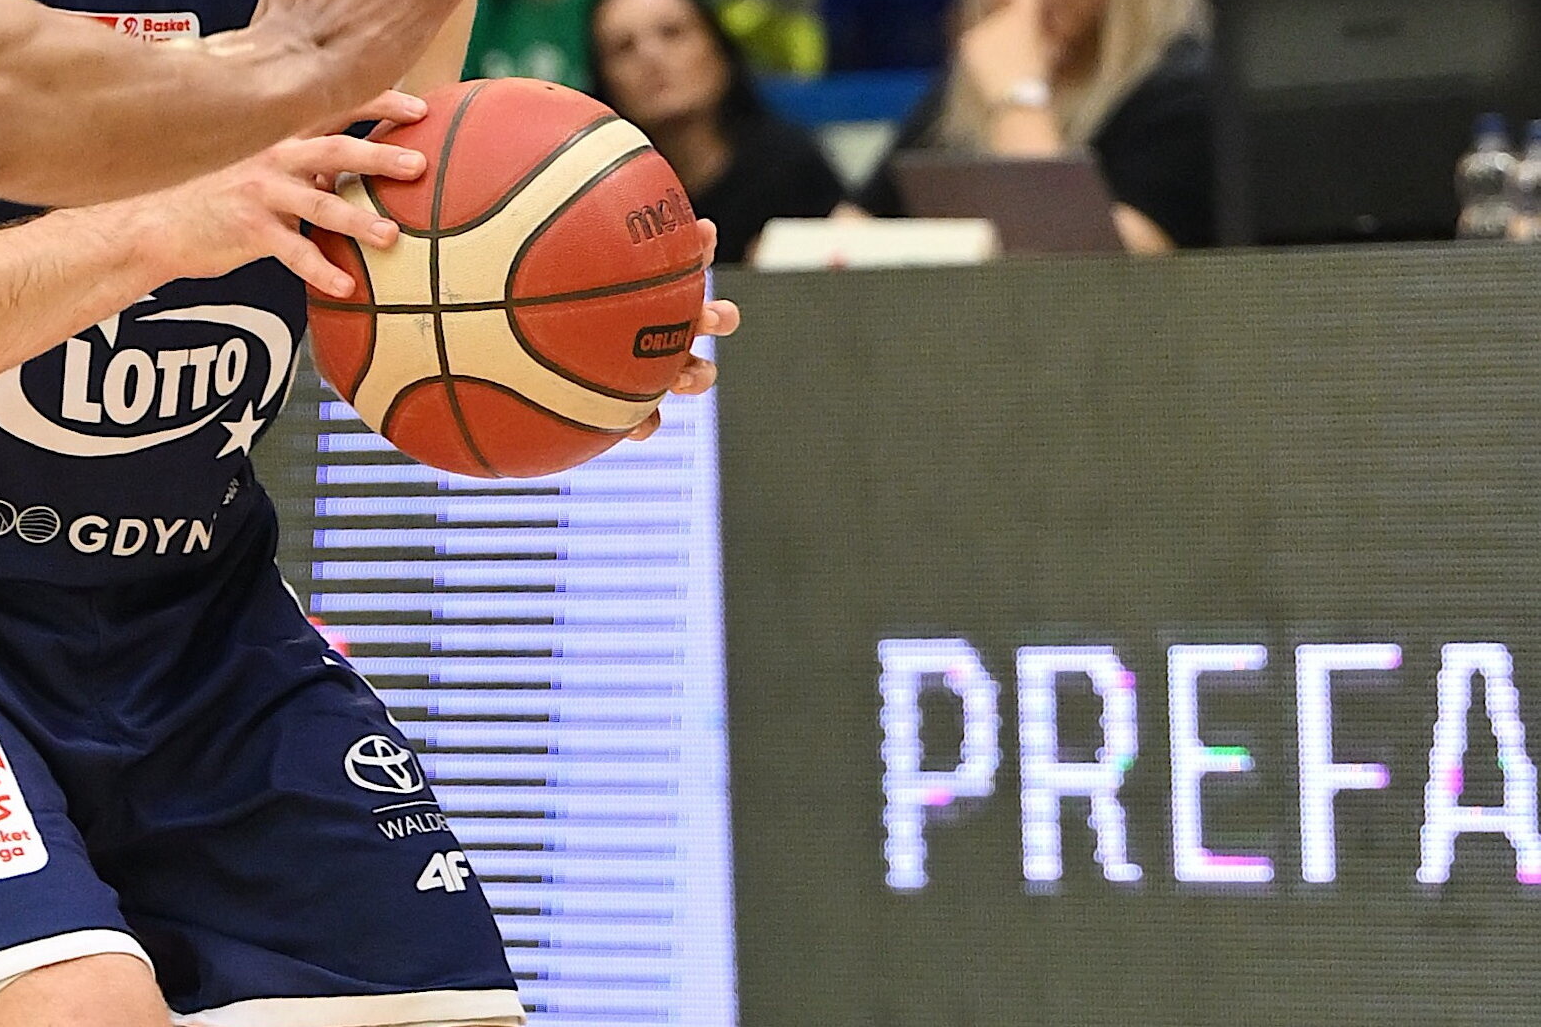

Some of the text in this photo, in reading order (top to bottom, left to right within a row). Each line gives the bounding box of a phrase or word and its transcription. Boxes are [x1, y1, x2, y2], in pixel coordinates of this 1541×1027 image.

[143, 18, 191, 33] Basket
[61, 337, 249, 425] LOTTO
[877, 638, 1541, 889] PREFA
